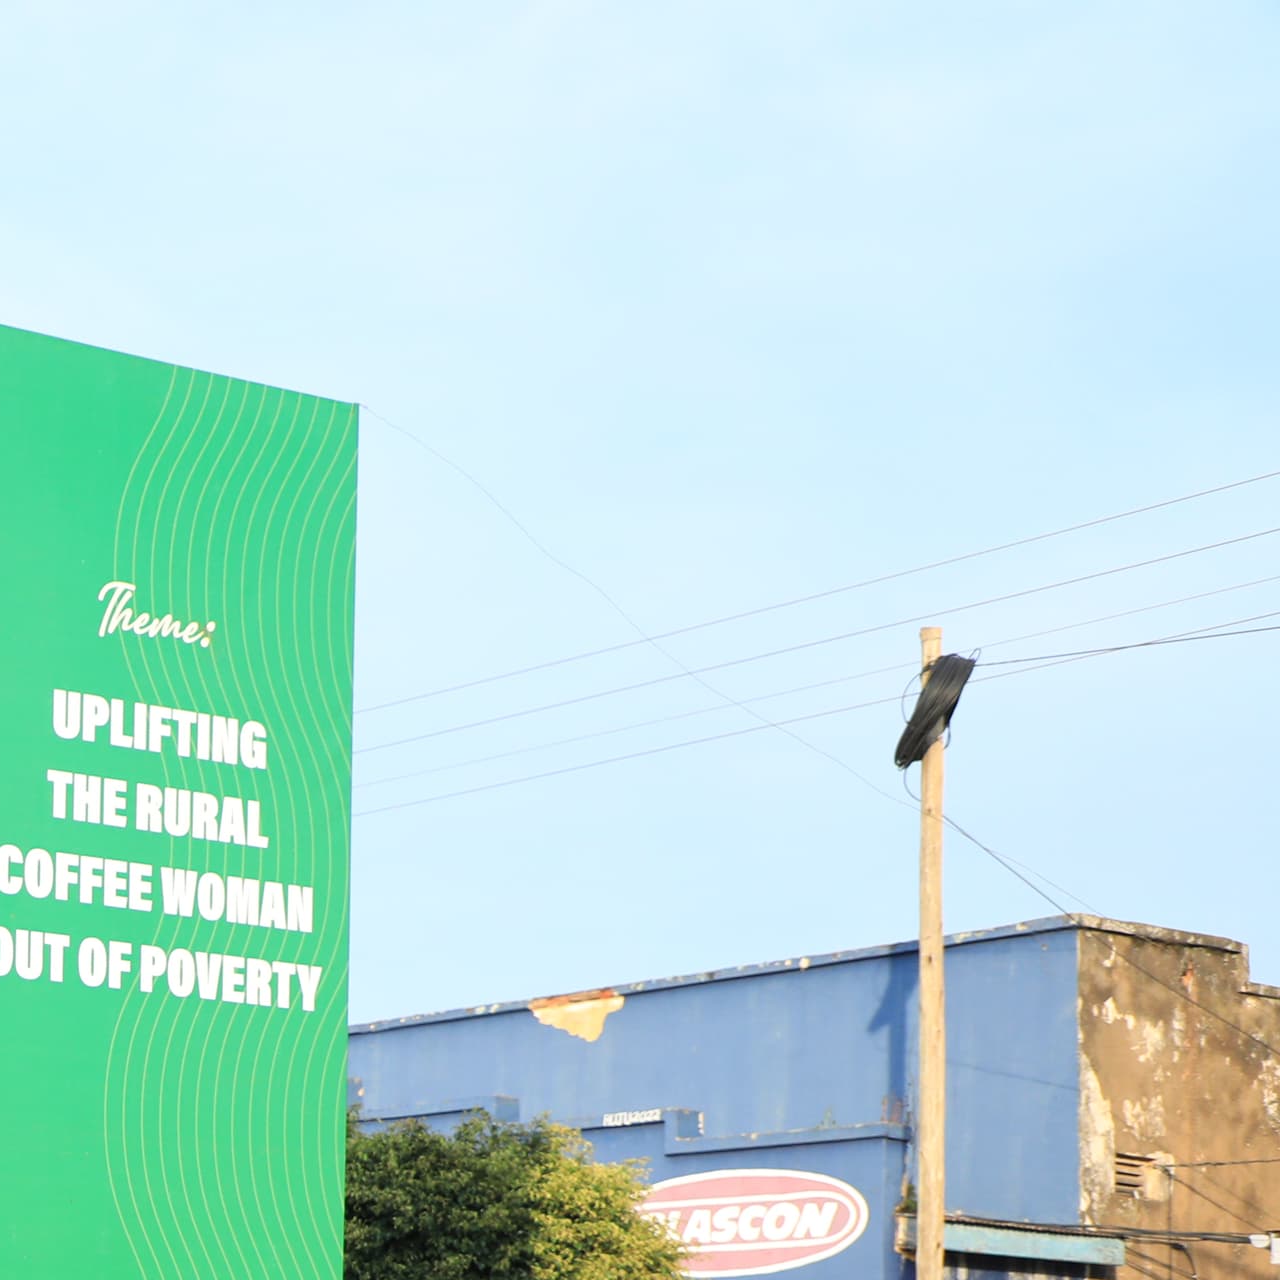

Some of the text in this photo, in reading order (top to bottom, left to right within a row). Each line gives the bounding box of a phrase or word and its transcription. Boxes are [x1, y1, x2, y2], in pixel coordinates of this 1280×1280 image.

[97, 581, 216, 648] Theme:
[52, 688, 268, 770] UPLIFTING
[46, 769, 269, 849] THE RURAL
[160, 866, 314, 933] WOMAN
[78, 937, 133, 989] OF
[140, 944, 323, 1012] POVERTY
